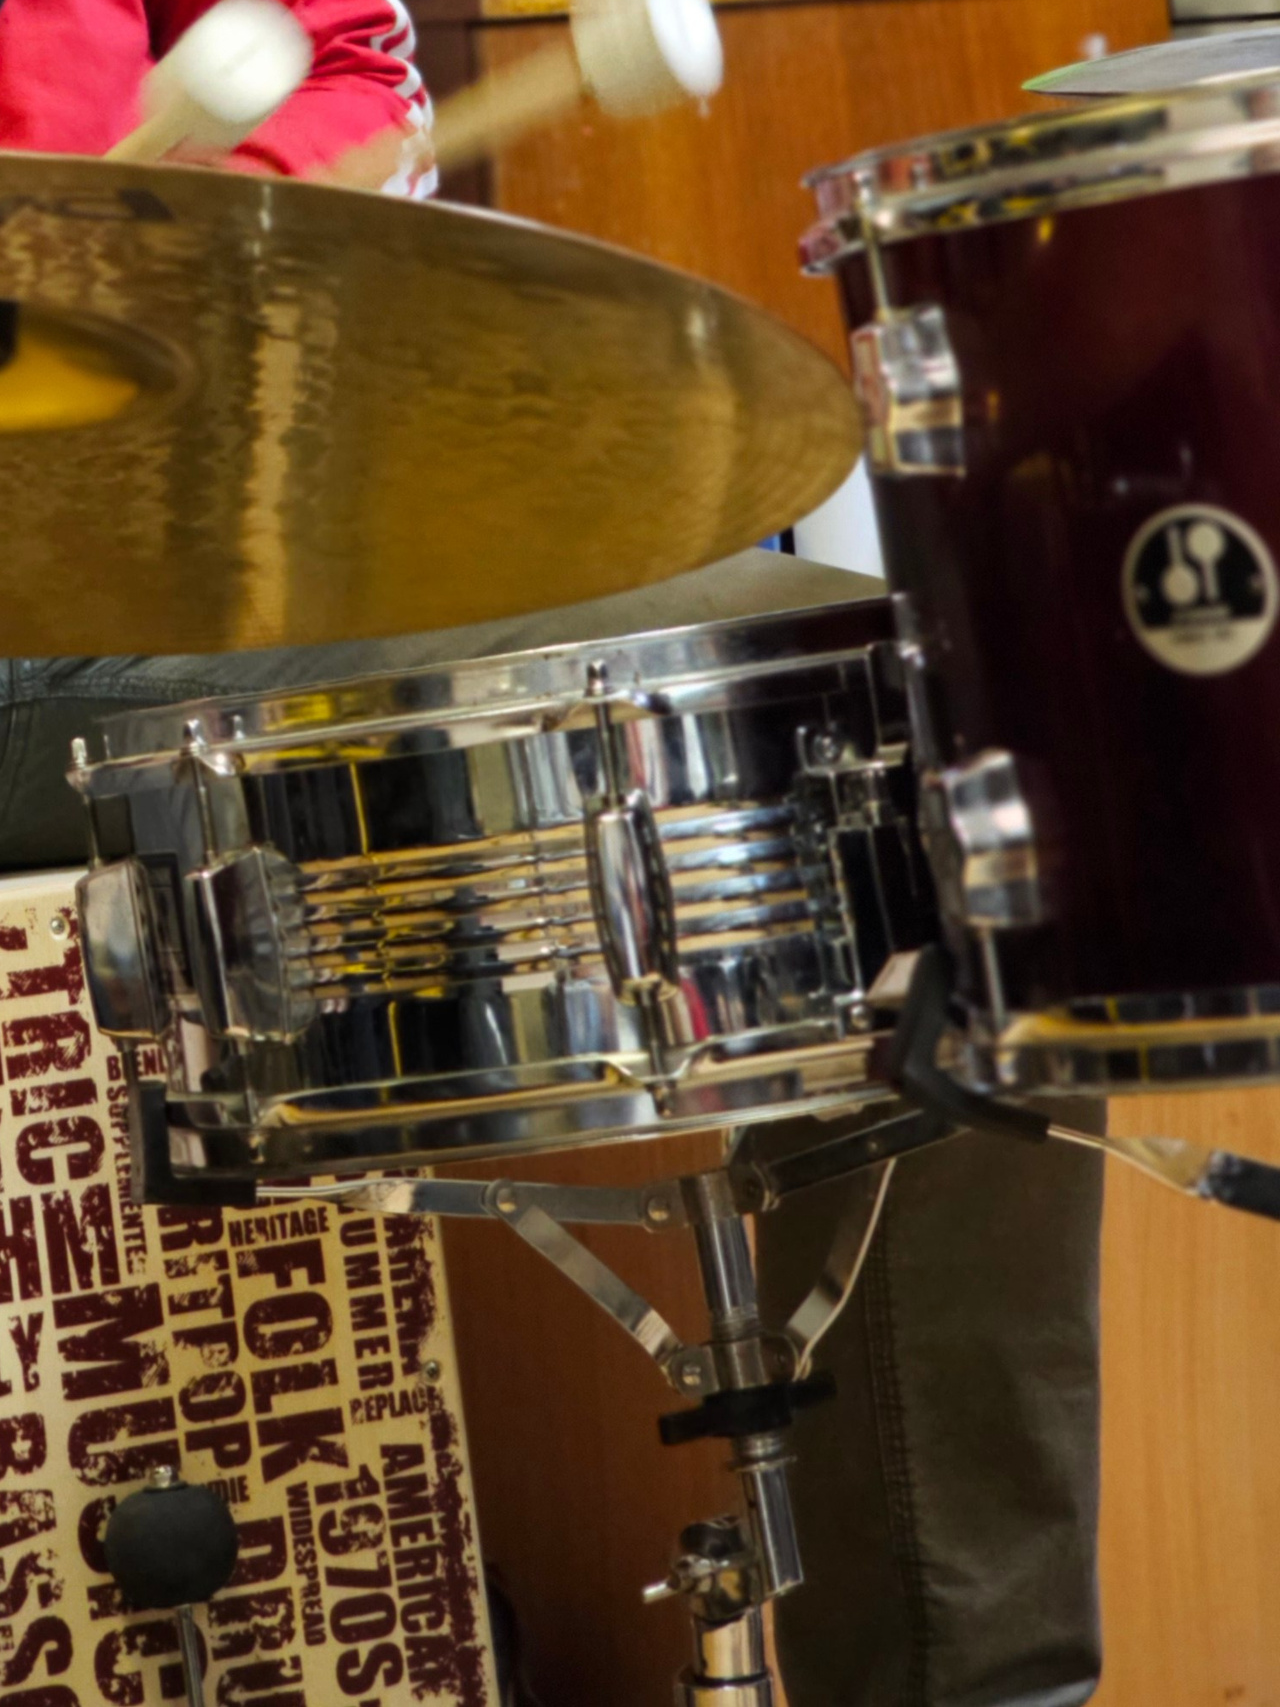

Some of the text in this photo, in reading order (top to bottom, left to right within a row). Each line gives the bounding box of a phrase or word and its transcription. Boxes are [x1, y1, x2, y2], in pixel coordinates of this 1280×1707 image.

[157, 1205, 253, 1471] RITPOP
[227, 1206, 330, 1248] HERITAGE
[336, 1172, 395, 1392] UMMER
[234, 1238, 350, 1483] FOLK
[286, 1481, 327, 1647] WIDESPREAD
[314, 1463, 405, 1697] 1970S
